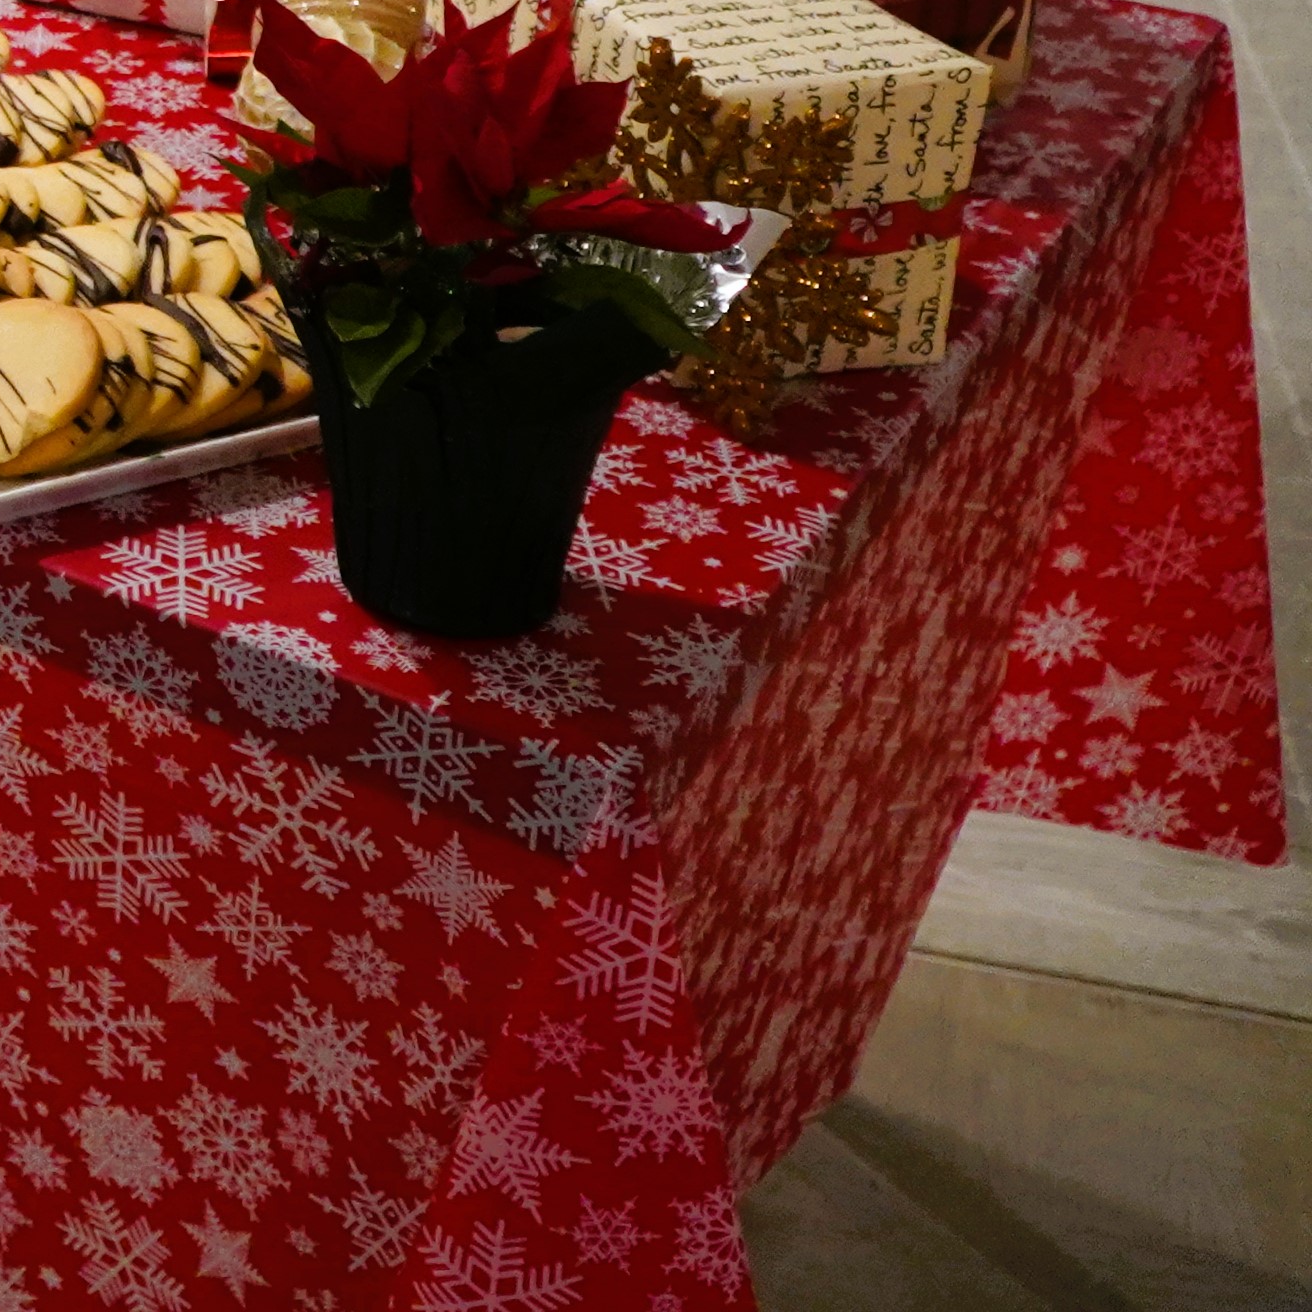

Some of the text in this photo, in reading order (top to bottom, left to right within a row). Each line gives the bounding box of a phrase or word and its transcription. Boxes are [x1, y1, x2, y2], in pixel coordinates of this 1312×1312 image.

[756, 63, 826, 81] from
[906, 82, 939, 178] Santa,
[936, 88, 972, 152] from
